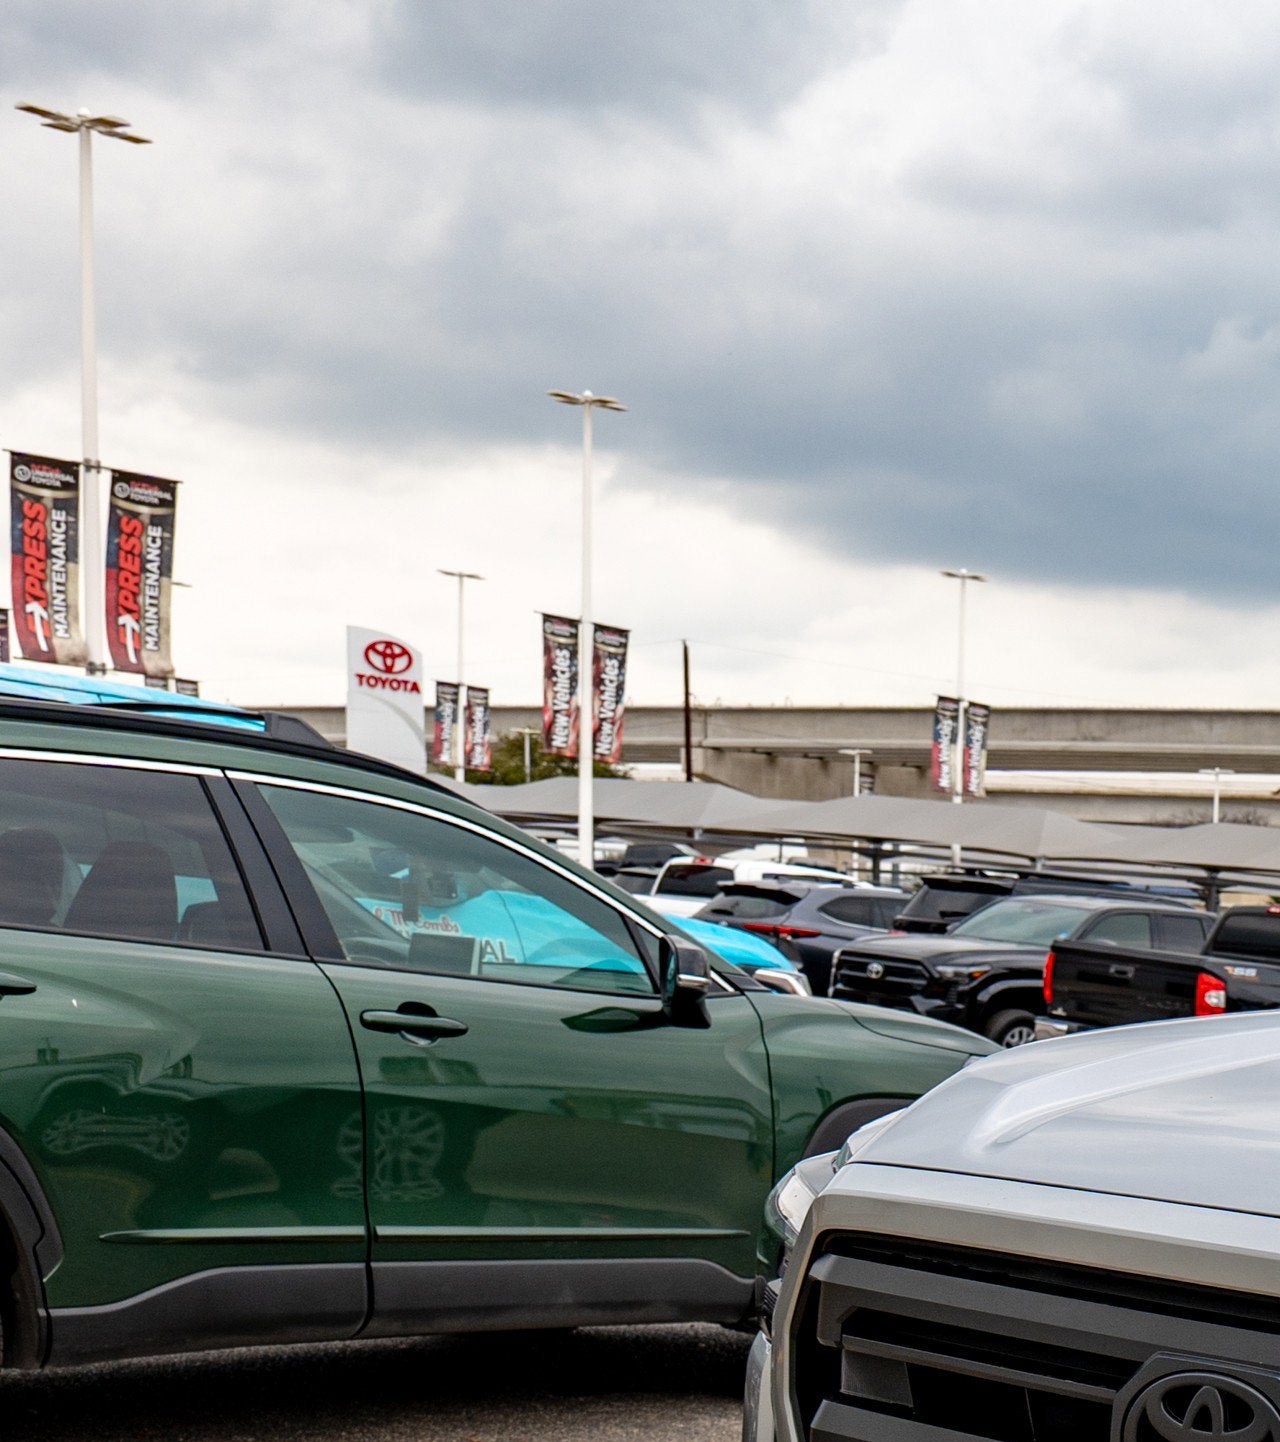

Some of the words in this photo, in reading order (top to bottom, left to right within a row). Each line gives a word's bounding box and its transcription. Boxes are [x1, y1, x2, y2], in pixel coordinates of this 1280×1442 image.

[22, 499, 50, 640] EXPRESS
[50, 508, 71, 639] MAINTENANCE
[117, 514, 144, 651] EXPRESS
[144, 524, 163, 652] MAINTENANCE
[355, 673, 421, 694] TOYOTA
[552, 647, 572, 711] Vehicles
[599, 657, 620, 720] Vehicles
[551, 711, 571, 749] New
[595, 720, 615, 756] New
